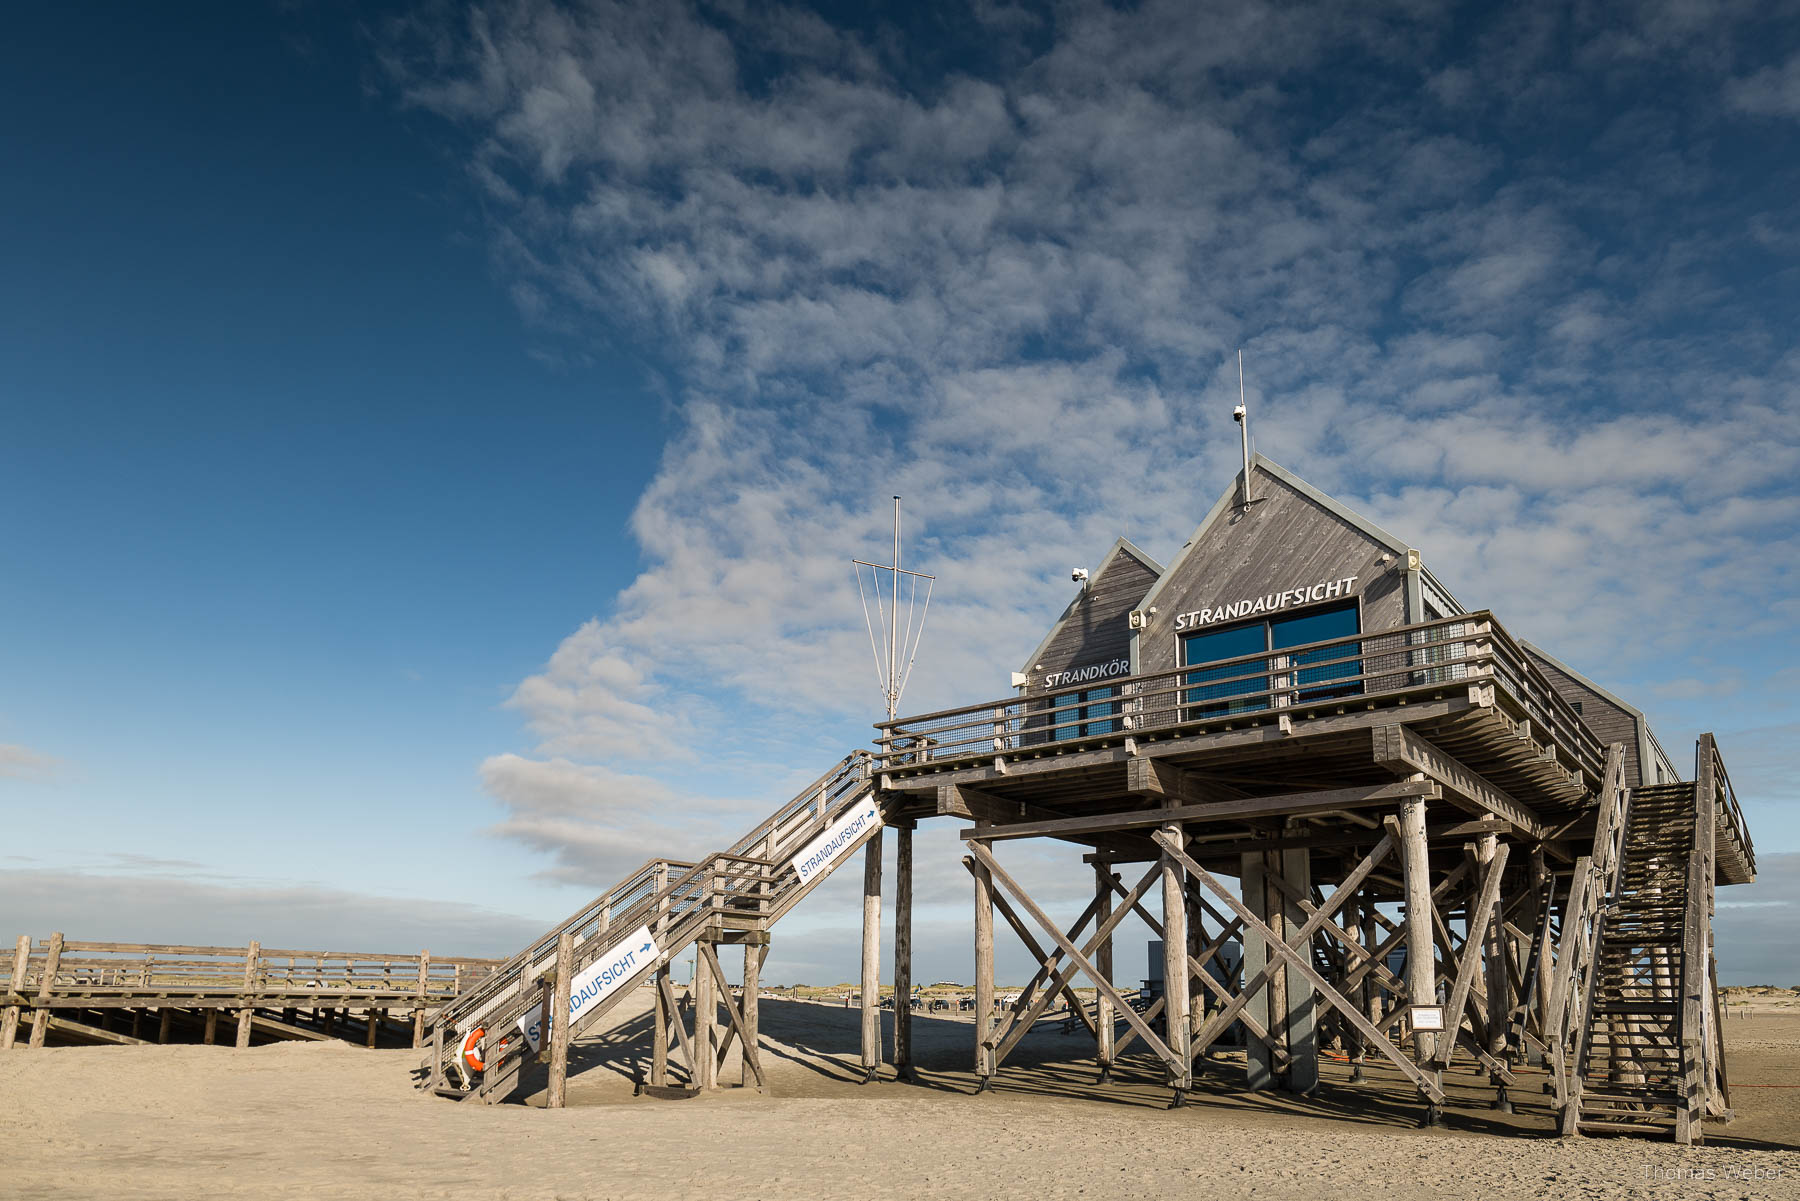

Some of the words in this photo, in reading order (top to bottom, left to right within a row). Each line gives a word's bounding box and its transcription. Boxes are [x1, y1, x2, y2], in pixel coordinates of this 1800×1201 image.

[1175, 576, 1358, 630] STRANDAUFSICHT
[800, 814, 867, 877] STRANDAUFSICHT
[528, 951, 637, 1042] SDAUFSICHT
